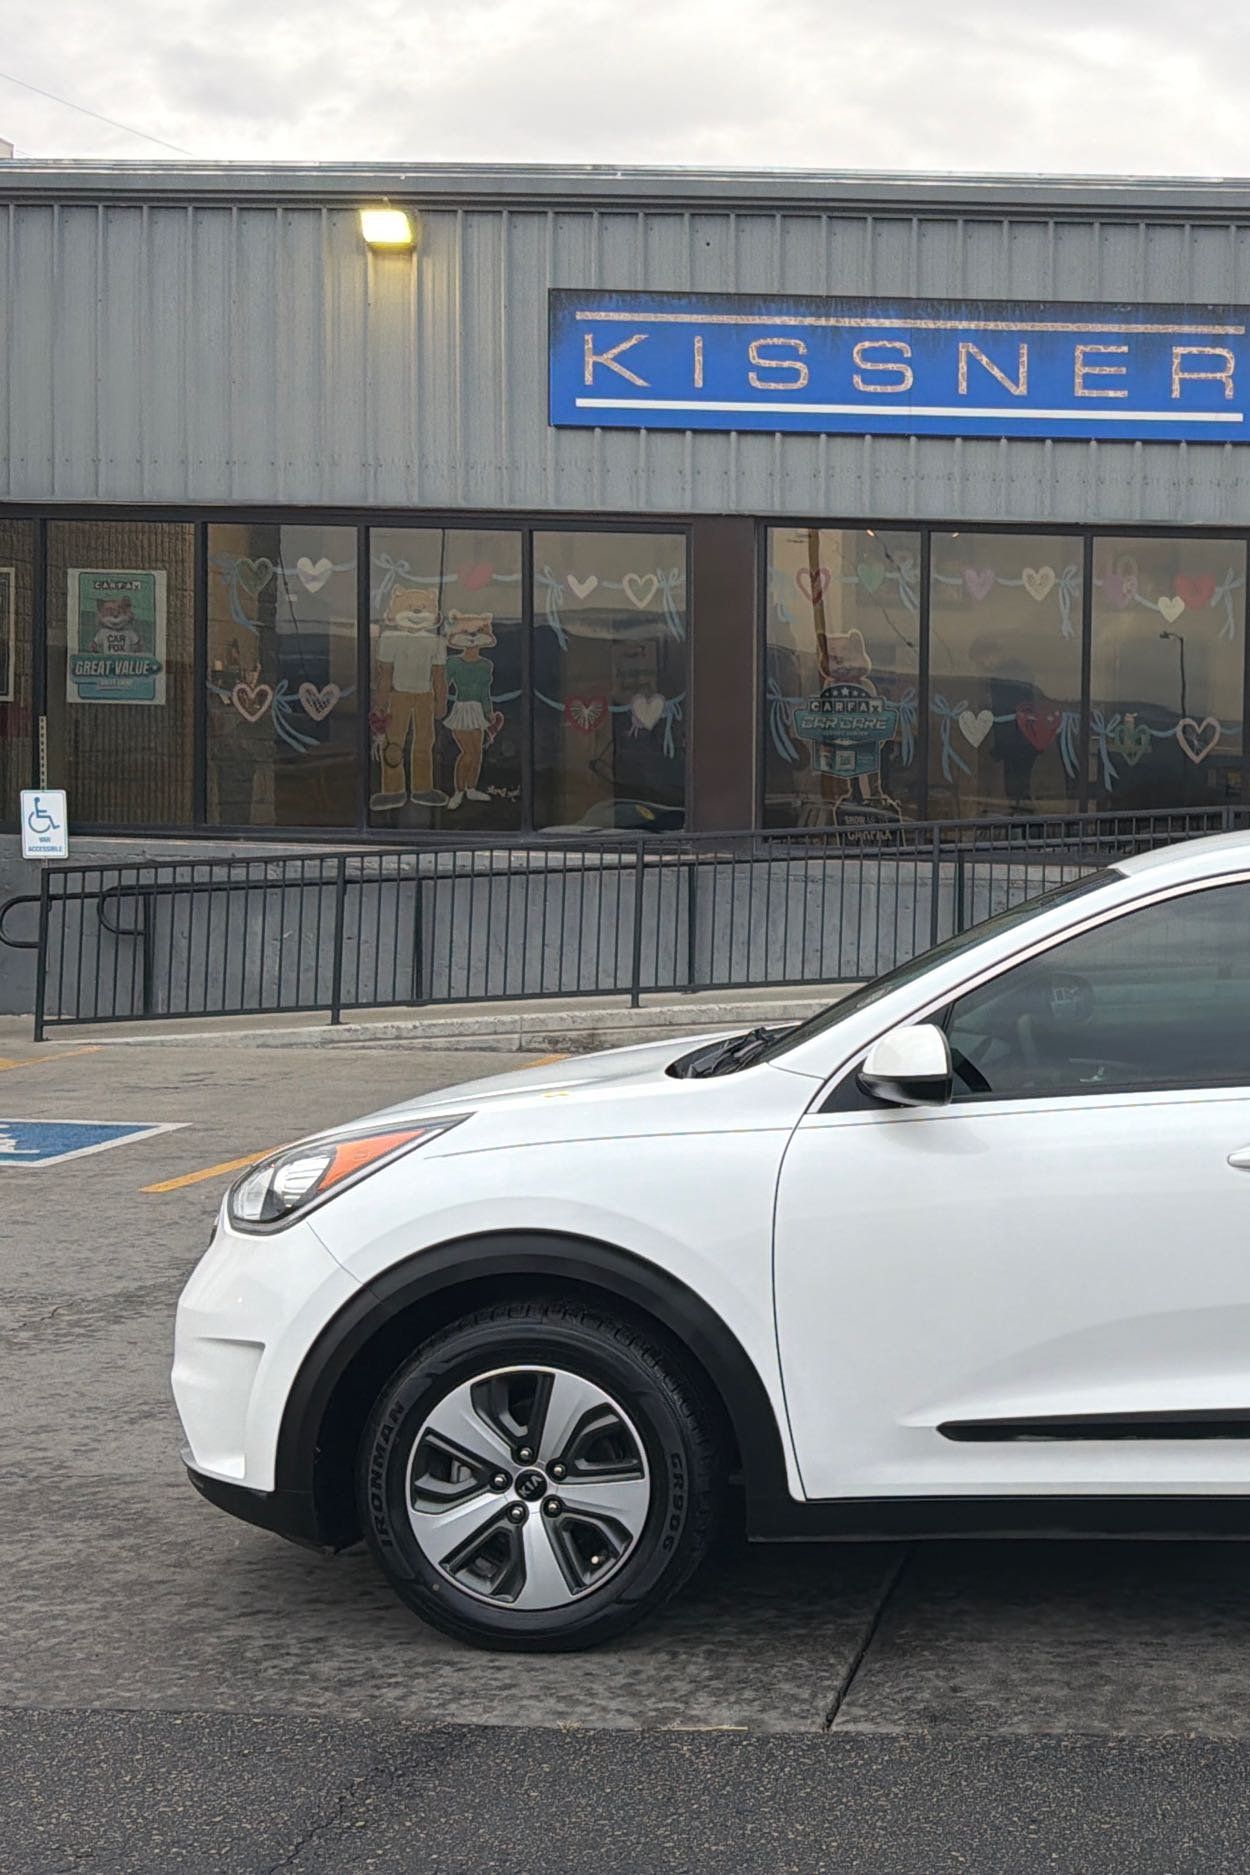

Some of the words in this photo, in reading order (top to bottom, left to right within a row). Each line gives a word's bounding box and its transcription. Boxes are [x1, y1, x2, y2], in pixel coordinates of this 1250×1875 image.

[582, 331, 1236, 400] KISSNER
[107, 634, 126, 643] CAR
[107, 643, 126, 652] FOX
[75, 660, 112, 676] GREAT
[114, 660, 150, 676] VALUE
[809, 700, 882, 714] CARFAX
[801, 717, 838, 729] CAR
[840, 717, 887, 729] CARE
[370, 1401, 405, 1547] IRONMAN
[518, 1475, 543, 1498] KIA
